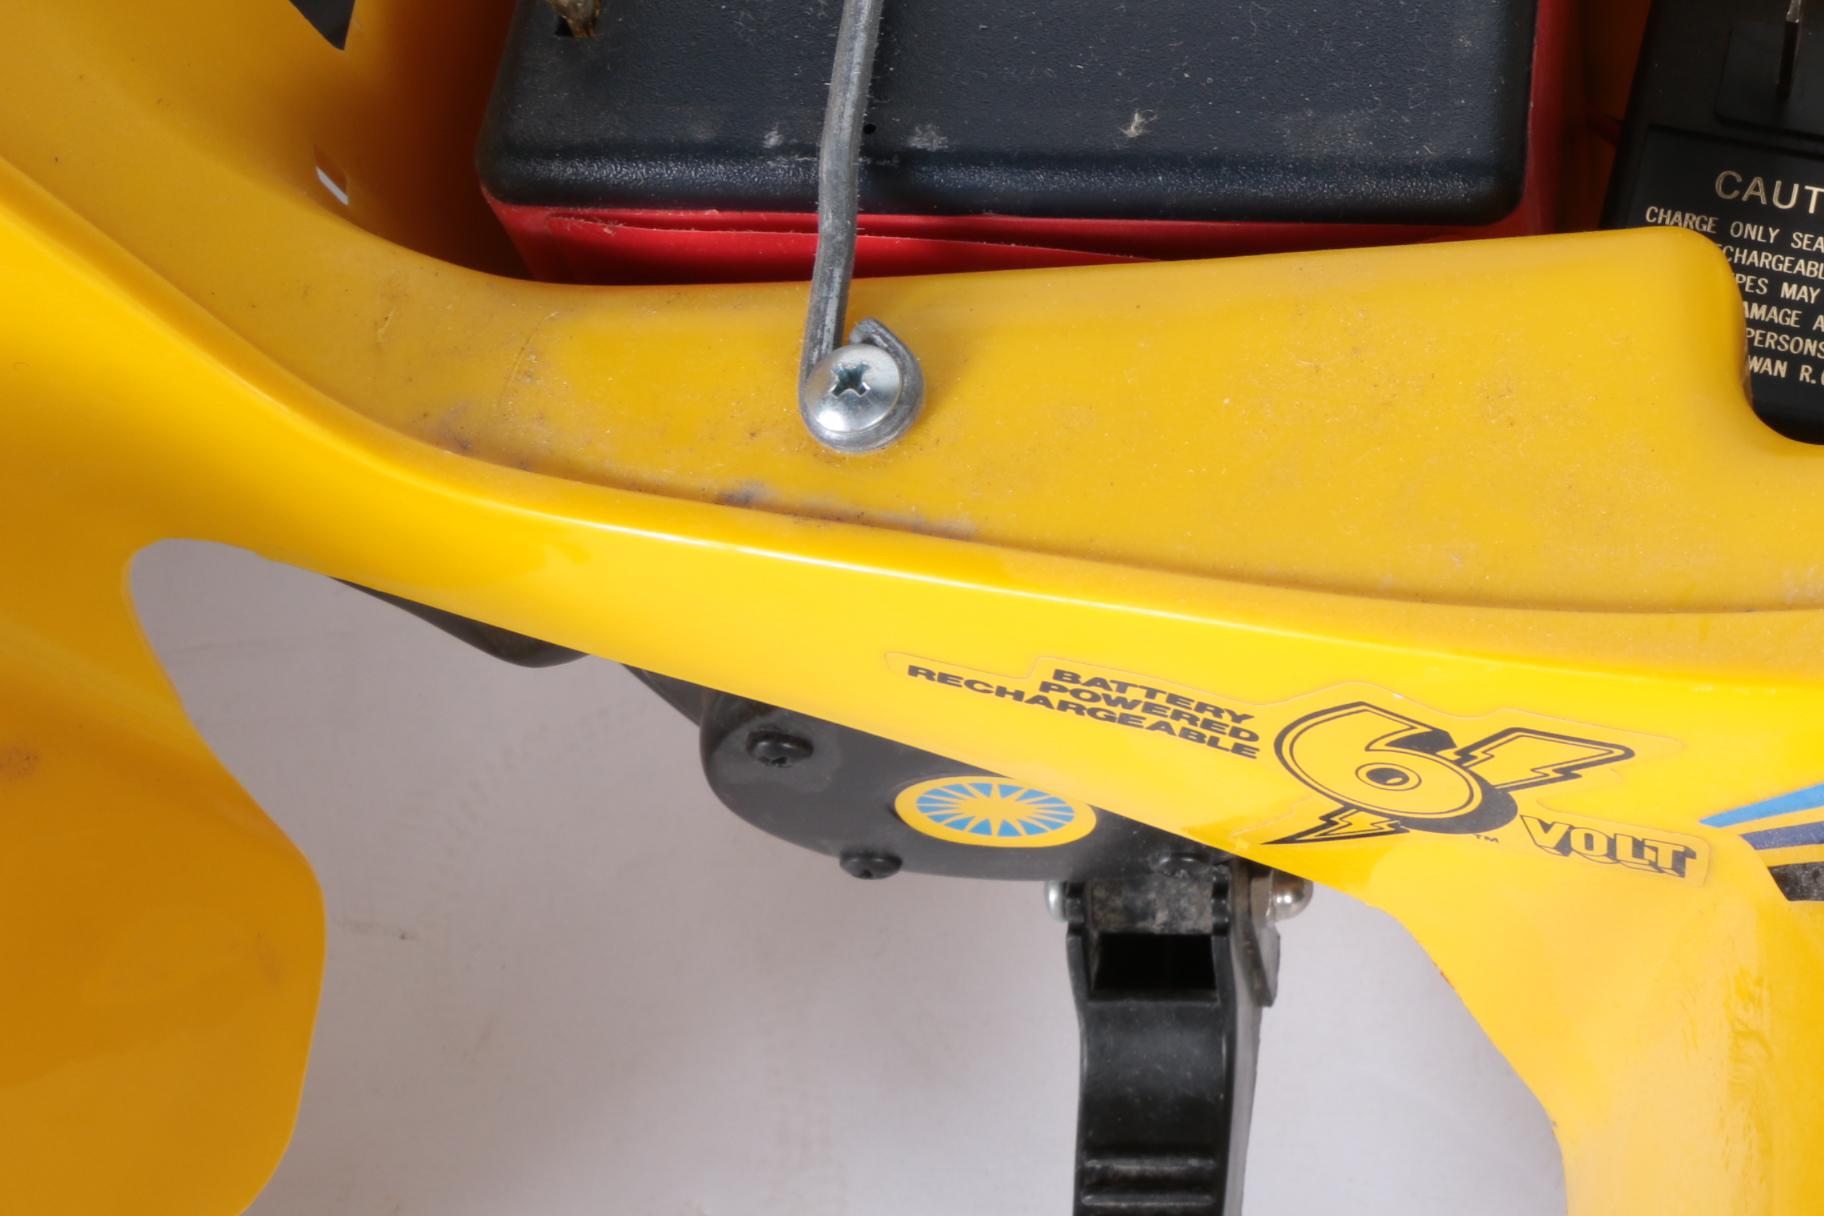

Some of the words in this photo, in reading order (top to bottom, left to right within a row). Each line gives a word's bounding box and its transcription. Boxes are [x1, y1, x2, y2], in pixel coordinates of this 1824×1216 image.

[1645, 205, 1718, 234] CHARGE
[1730, 220, 1781, 245] ONLY
[1734, 272, 1768, 295] PES
[1780, 282, 1821, 304] MAY
[1743, 300, 1801, 329] AMAGE
[1748, 355, 1788, 379] WAN
[906, 664, 1260, 760] RECHARGEABLE
[1038, 680, 1261, 743] POWERED
[1050, 667, 1256, 726] BATTERY
[1520, 815, 1700, 880] VOLT
